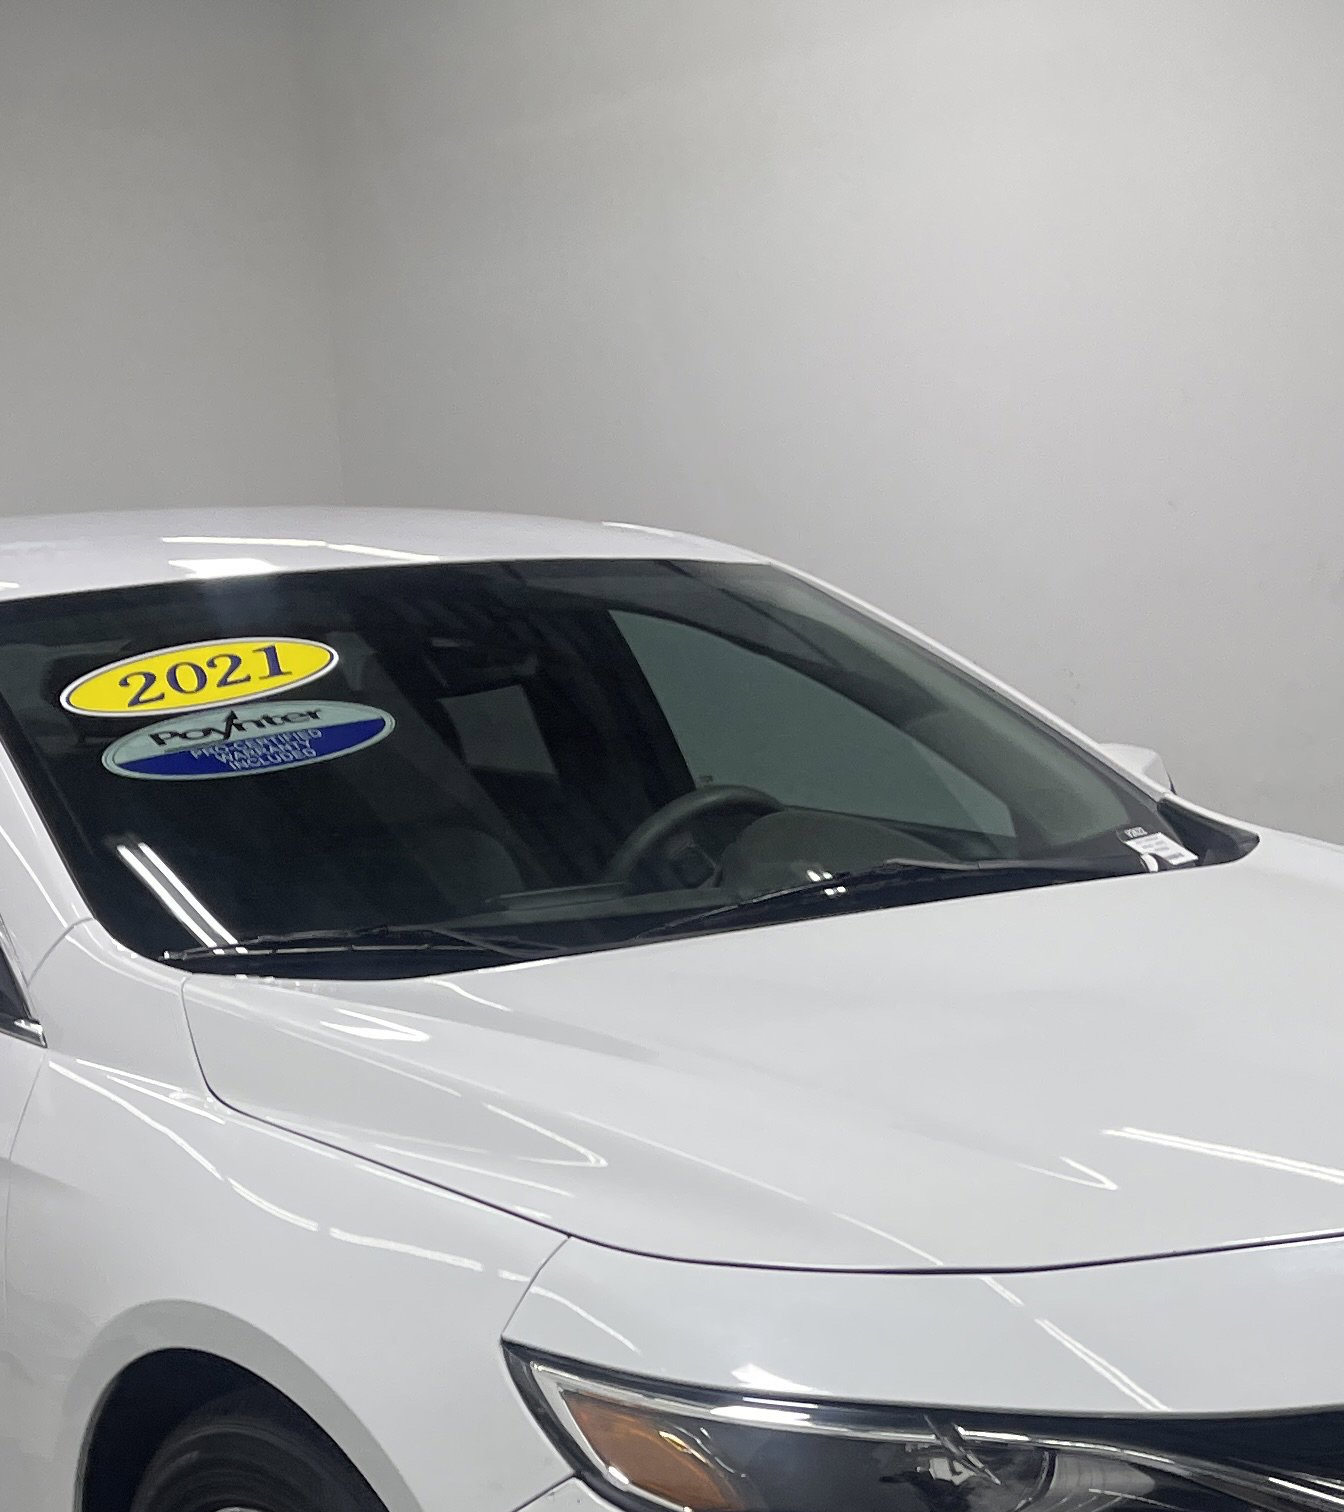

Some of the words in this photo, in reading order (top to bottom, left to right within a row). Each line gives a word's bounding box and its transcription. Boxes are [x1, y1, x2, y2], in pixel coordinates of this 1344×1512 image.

[119, 645, 292, 707] 2021
[150, 711, 321, 747] Poynter
[214, 740, 312, 764] WARRANTY
[229, 748, 317, 771] INCLUDED
